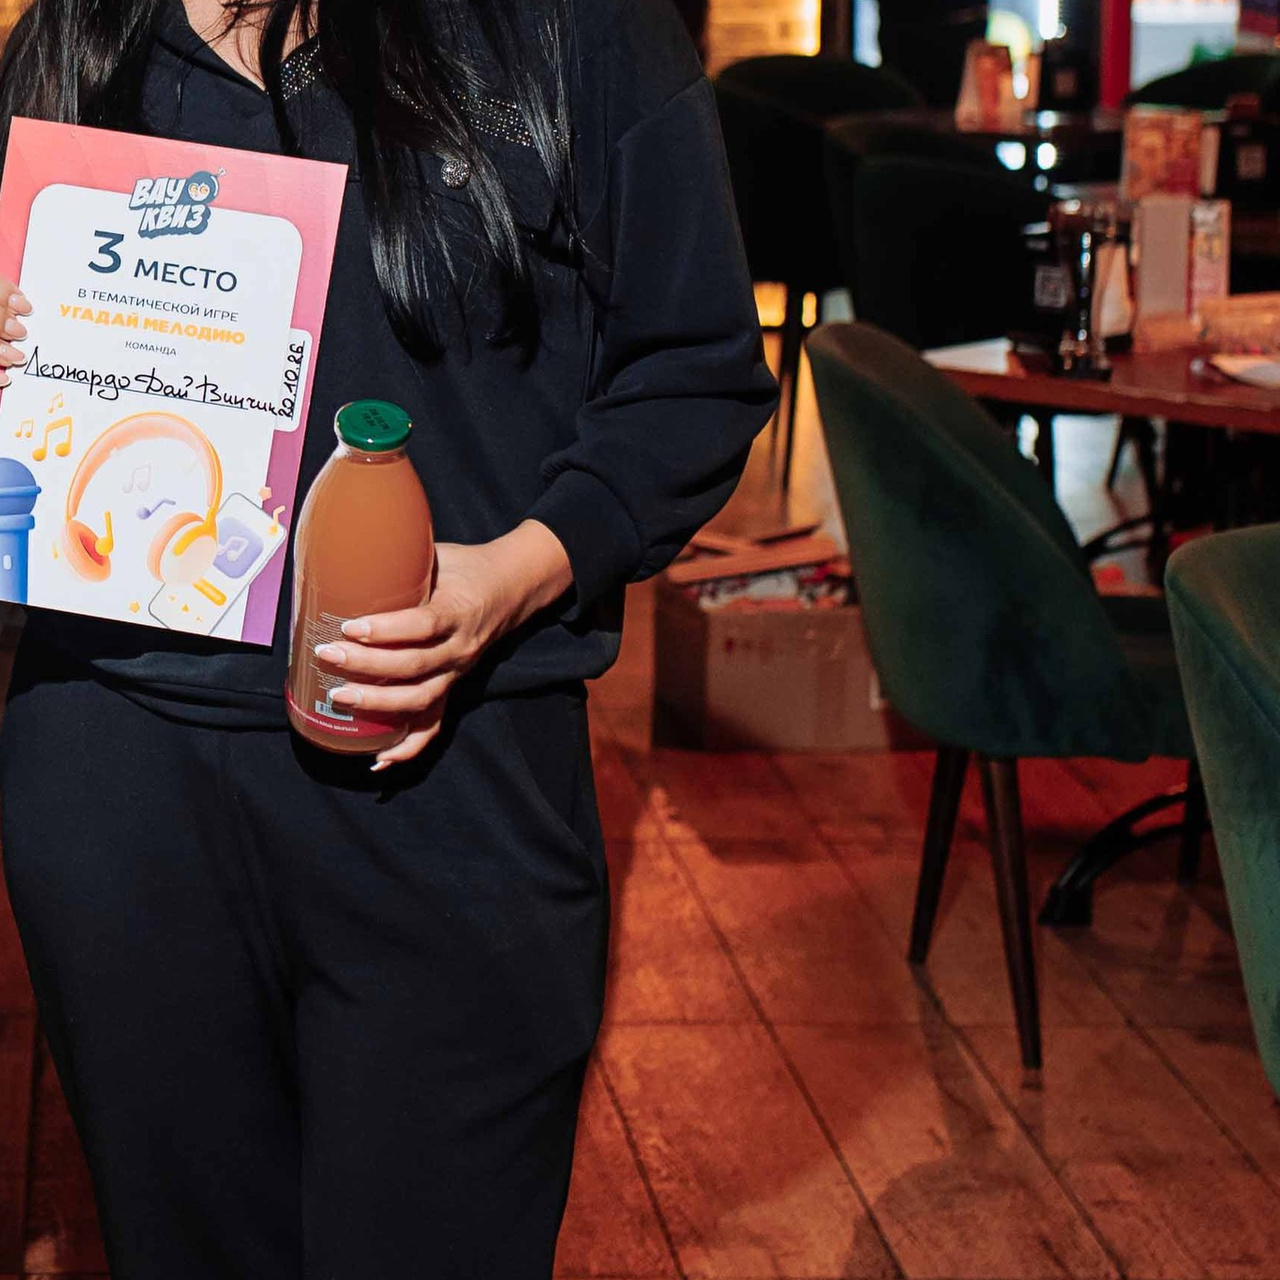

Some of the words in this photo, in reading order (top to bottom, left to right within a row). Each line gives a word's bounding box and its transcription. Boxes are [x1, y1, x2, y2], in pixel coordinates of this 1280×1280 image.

[129, 177, 187, 210] ВАУ
[138, 204, 210, 237] КВИЗ
[87, 230, 125, 275] 3
[133, 258, 238, 293] МЕСТО
[78, 288, 87, 298] В
[91, 289, 201, 316] ТЕМАТИЧЕСКОЙ
[203, 308, 239, 322] ИГРЕ
[60, 303, 139, 329] УГАДАЙ
[143, 318, 245, 345] МЕЛОДИЮ
[125, 340, 177, 357] КОМАНДА
[24, 346, 131, 401] Леонардо
